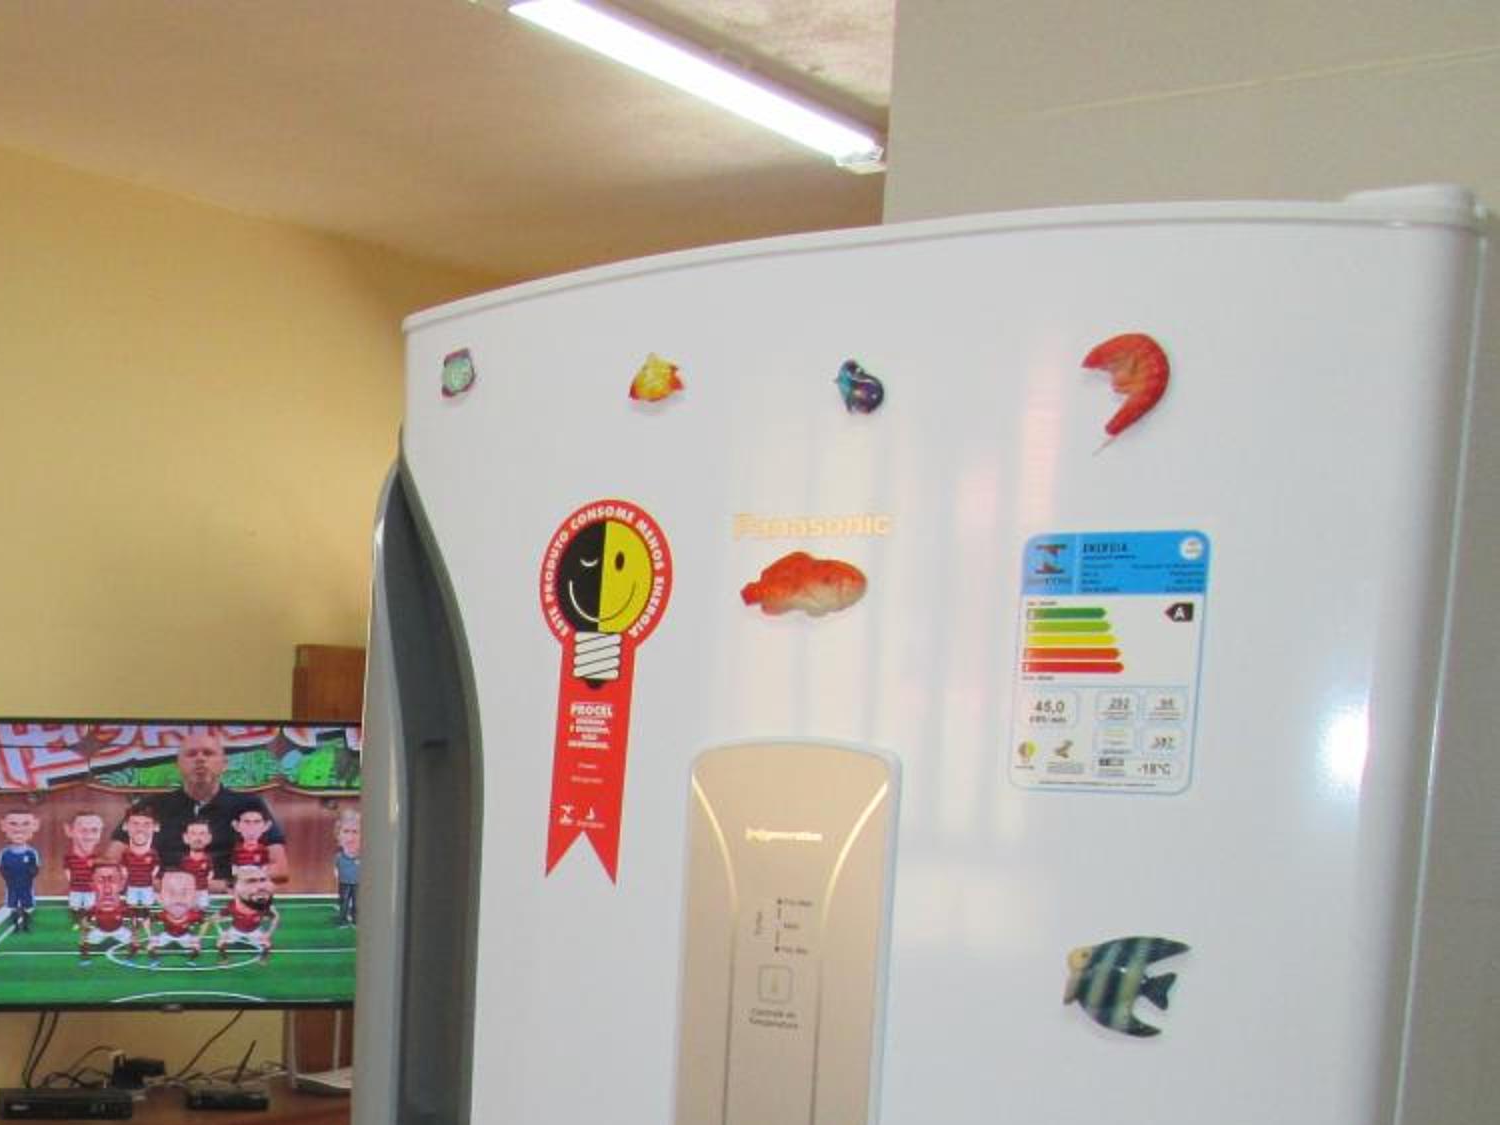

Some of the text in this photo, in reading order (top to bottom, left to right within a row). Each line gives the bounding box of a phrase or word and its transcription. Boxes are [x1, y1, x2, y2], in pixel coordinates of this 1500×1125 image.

[544, 505, 665, 638] ESTE PRODUTO CONSOME MENOS ENERGIA
[1174, 606, 1185, 619] A
[570, 703, 613, 718] PROCEL
